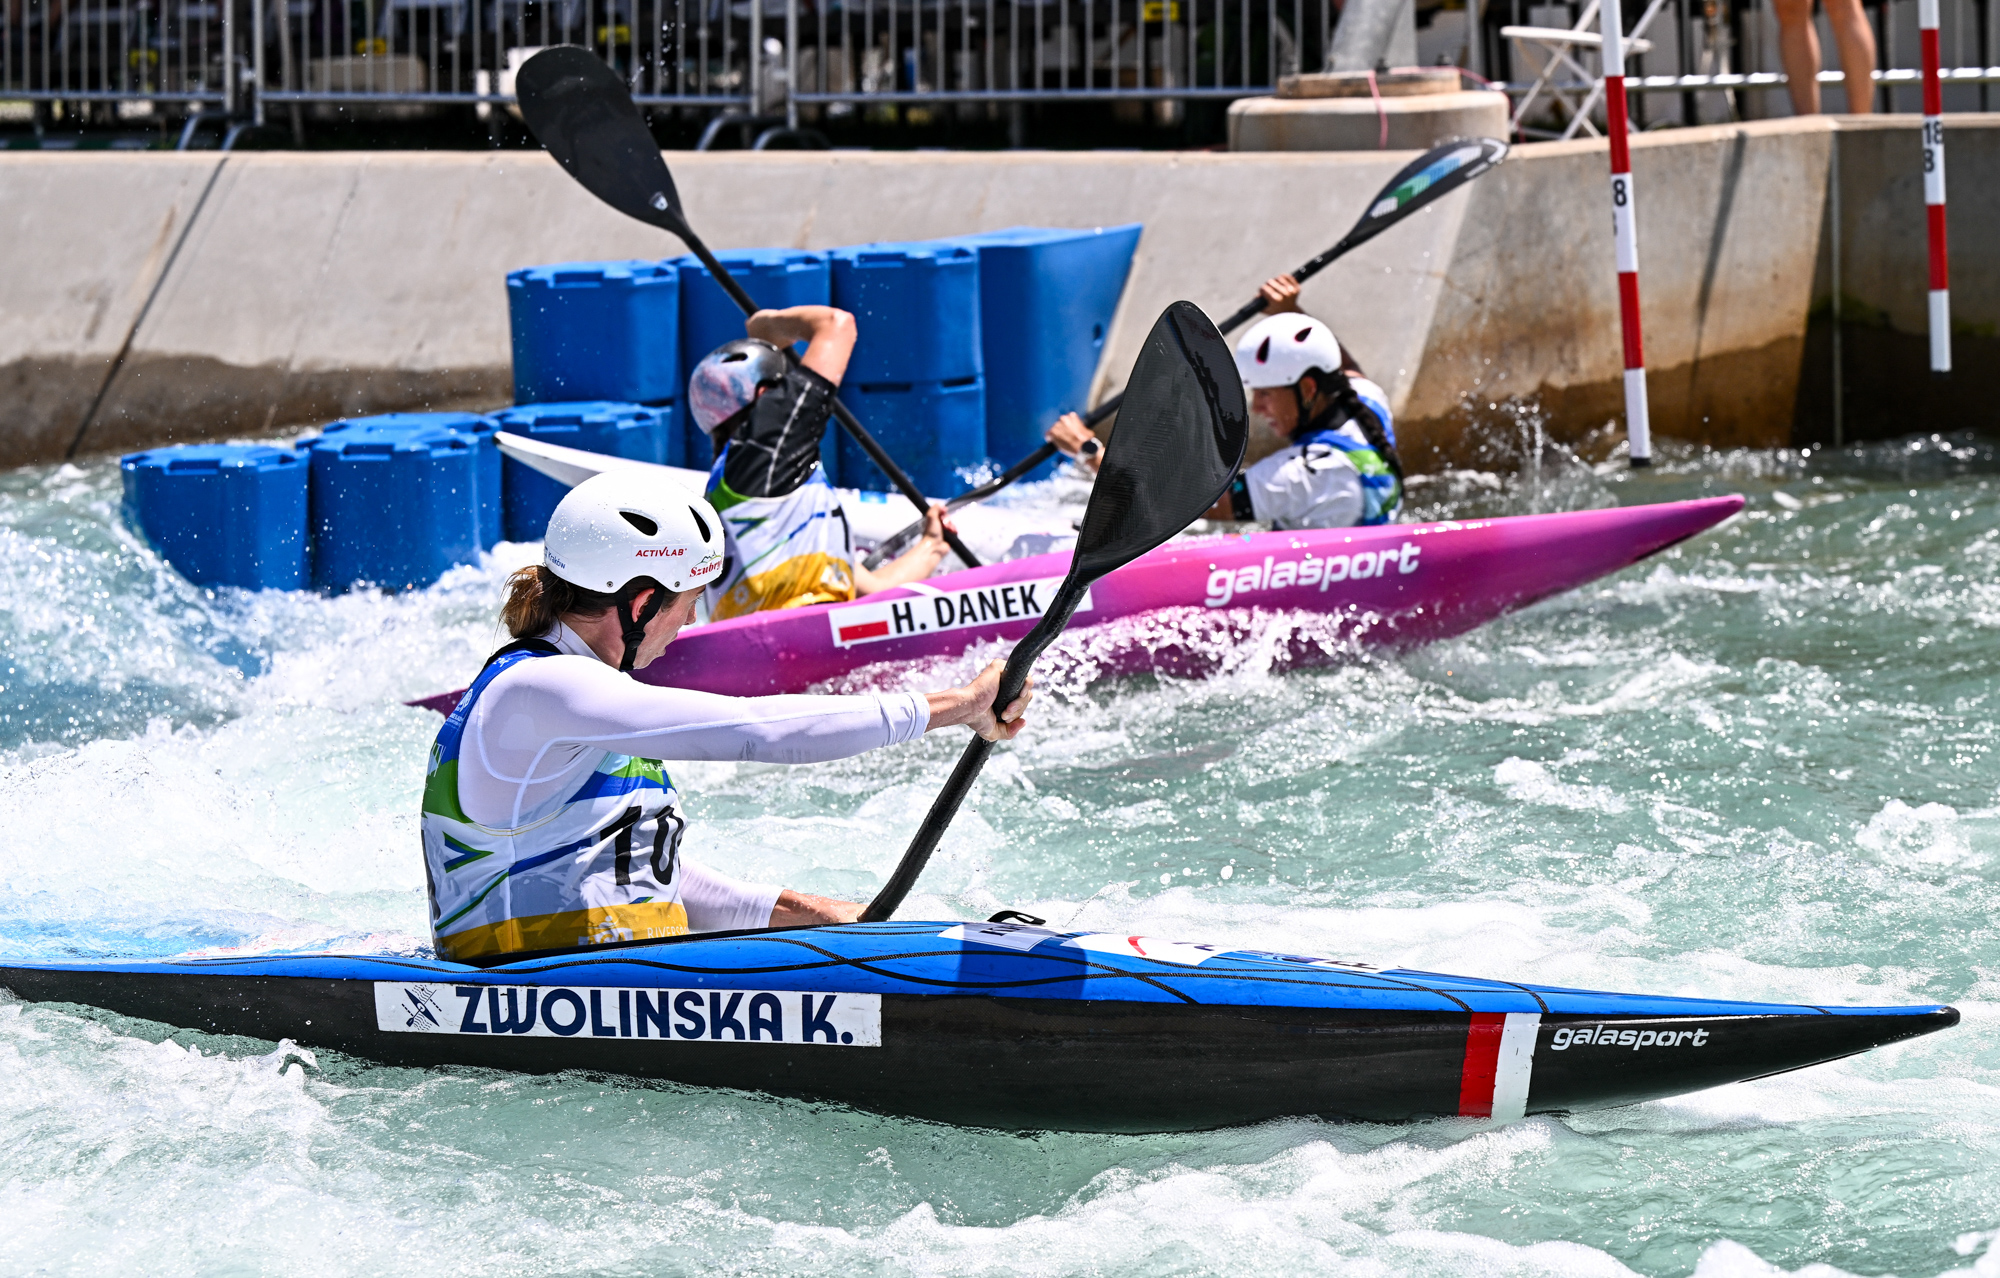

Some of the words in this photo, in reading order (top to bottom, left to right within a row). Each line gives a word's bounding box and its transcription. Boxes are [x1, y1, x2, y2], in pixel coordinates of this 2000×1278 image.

[635, 547, 686, 557] ACTIVLAB
[1205, 541, 1421, 608] galasport
[892, 602, 927, 633] H.
[934, 584, 1041, 627] DANEK
[455, 986, 784, 1042] ZWOLINSKA
[802, 994, 854, 1045] K.
[1551, 1024, 1710, 1051] galasport
